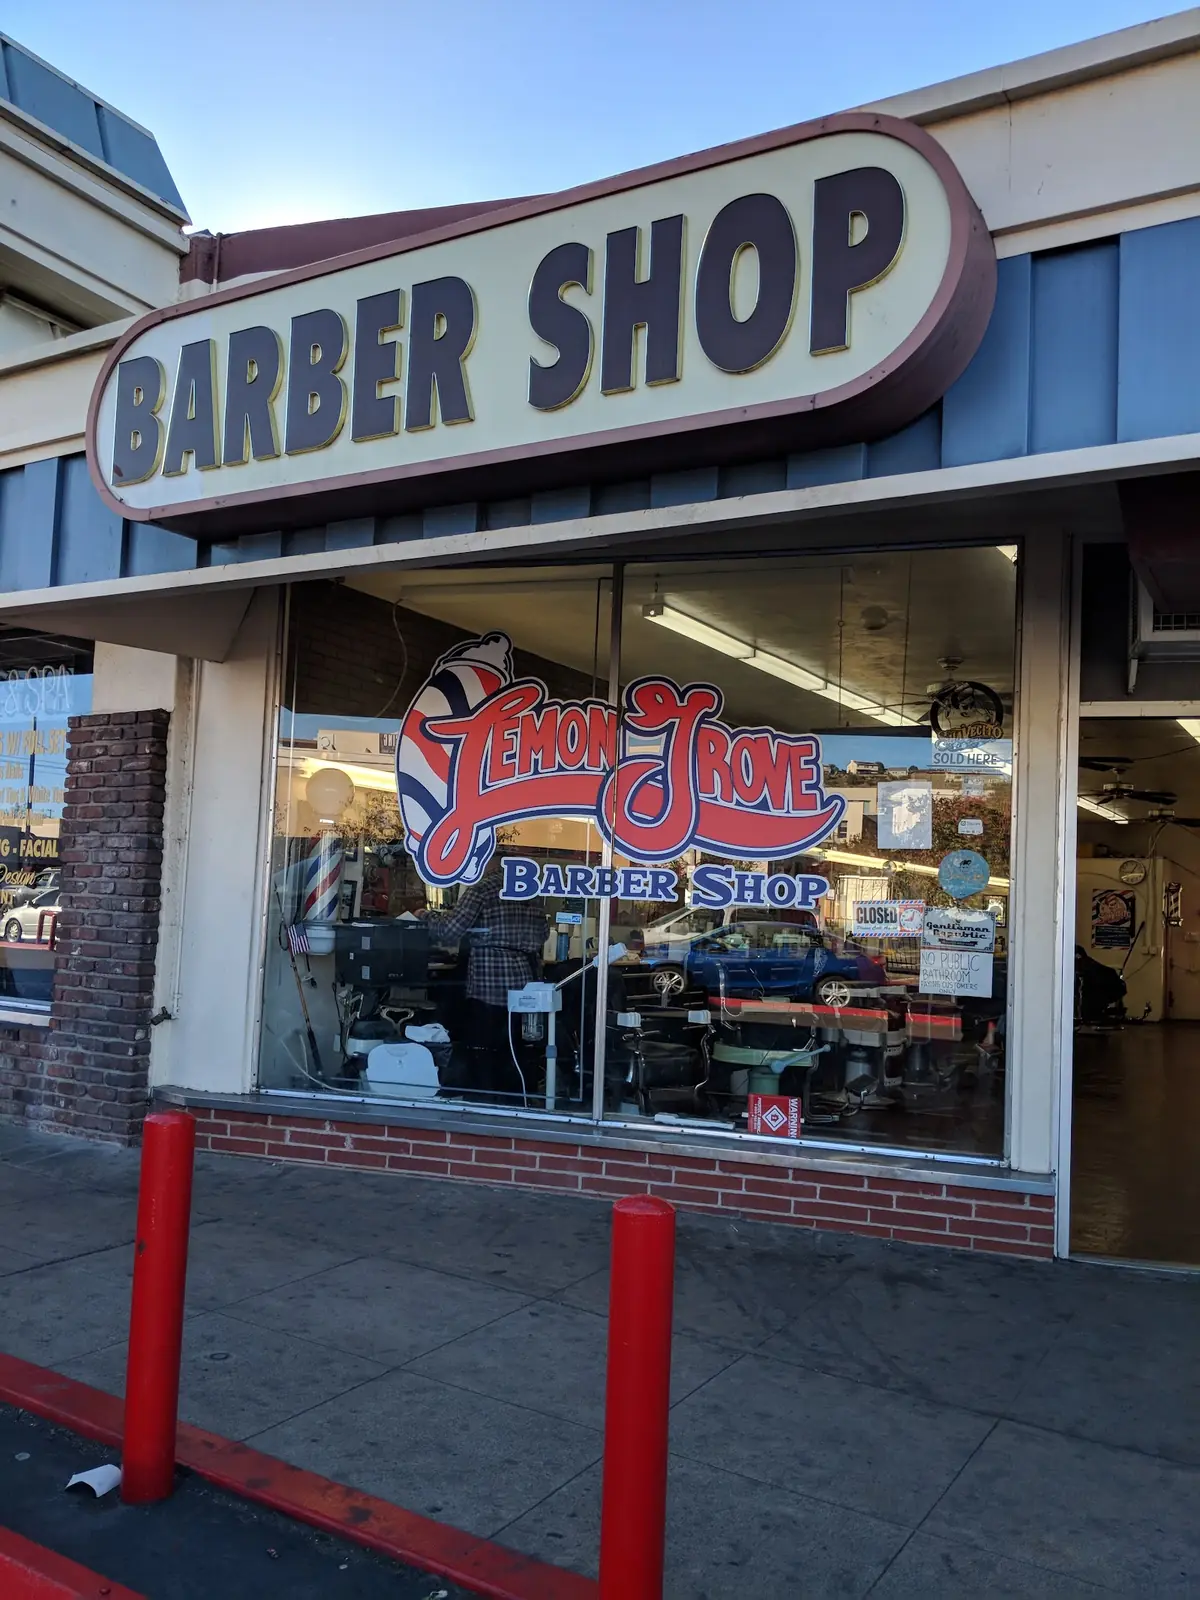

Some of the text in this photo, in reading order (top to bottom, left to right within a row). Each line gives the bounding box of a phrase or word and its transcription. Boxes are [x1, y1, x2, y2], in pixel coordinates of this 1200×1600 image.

[110, 165, 908, 487] BARBER SHOP
[25, 664, 71, 715] SPA
[933, 752, 997, 766] SOLD HERE
[422, 681, 838, 877] LEMON GROVE
[19, 838, 58, 858] FACIAL
[501, 857, 829, 909] BARBER SHOP
[856, 906, 898, 924] CLOSED
[926, 921, 990, 933] Gentlemen
[921, 951, 980, 972] NO PUBLIC
[922, 968, 971, 983] BATHROOM
[941, 982, 978, 991] CUSTOMERS
[790, 1098, 798, 1139] WARNIN
